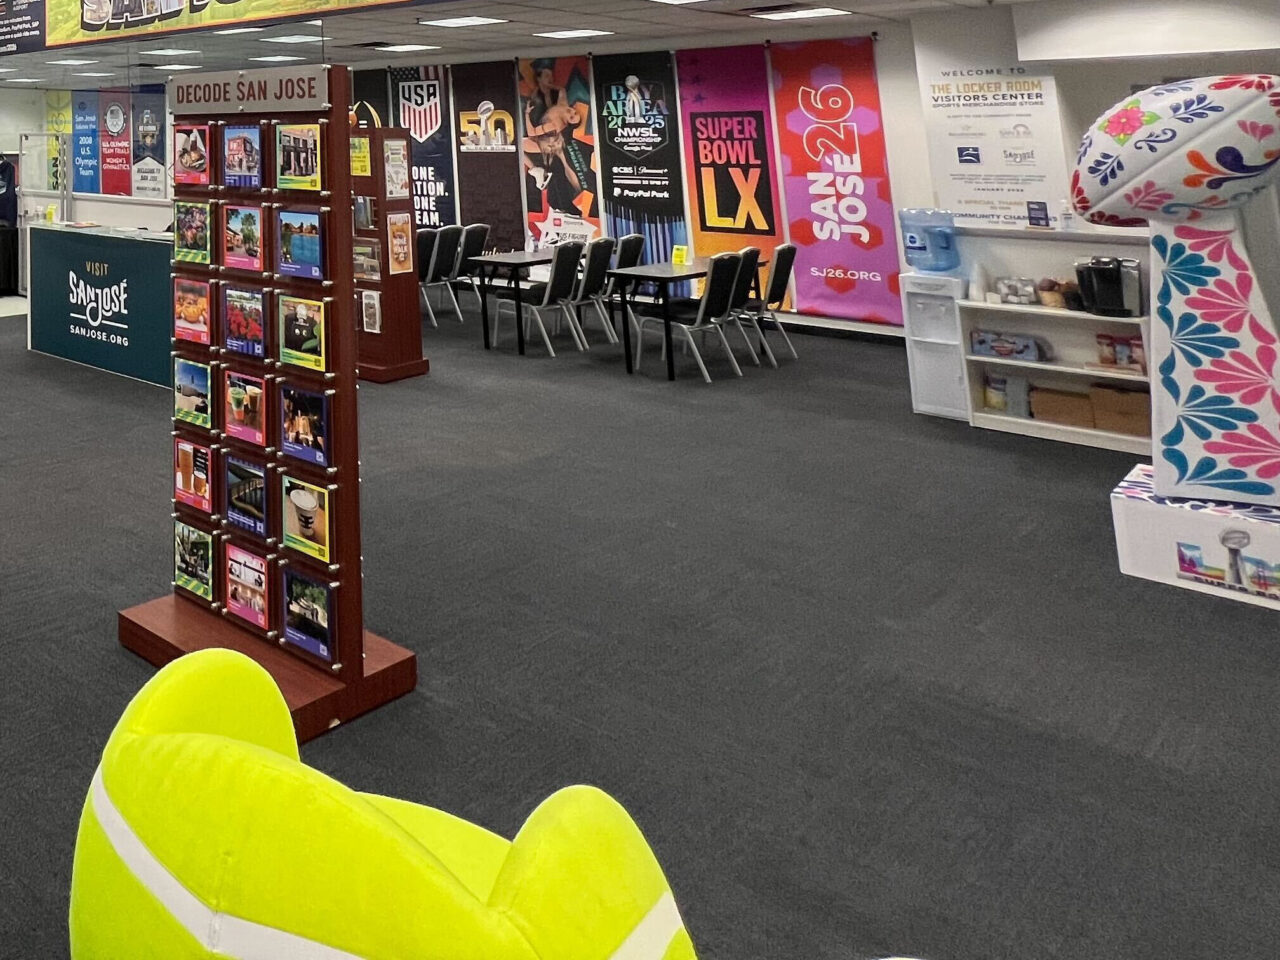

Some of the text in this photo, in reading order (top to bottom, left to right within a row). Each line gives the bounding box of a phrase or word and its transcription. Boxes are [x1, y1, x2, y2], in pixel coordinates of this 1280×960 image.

[941, 68, 1002, 77] WELCOME
[176, 77, 317, 104] DECODE SAN JOSE
[402, 83, 437, 107] USA
[611, 85, 654, 100] BY
[930, 81, 1042, 94] THE LOCKER ROOM
[932, 94, 988, 102] VISITORS
[460, 110, 515, 145] 50
[695, 116, 757, 139] SUPER
[798, 84, 861, 163] 26
[618, 127, 658, 137] NWSL
[80, 146, 92, 155] U.S.
[699, 140, 761, 164] BOWL
[75, 156, 98, 168] Olympic
[79, 167, 94, 176] Team
[412, 166, 435, 181] ONE
[620, 166, 633, 174] CBS
[413, 181, 449, 196] TION.
[623, 189, 669, 199] PayPal Park
[414, 196, 437, 211] ONE
[700, 167, 769, 230] LX
[807, 171, 840, 241] SAN
[825, 153, 870, 244] JOSÉ
[415, 211, 444, 227] EAM.
[85, 261, 109, 276] VISIT
[810, 267, 882, 282] SJ26.ORG
[70, 324, 129, 346] SANJOSE.ORG
[1194, 576, 1249, 593] SUPER
